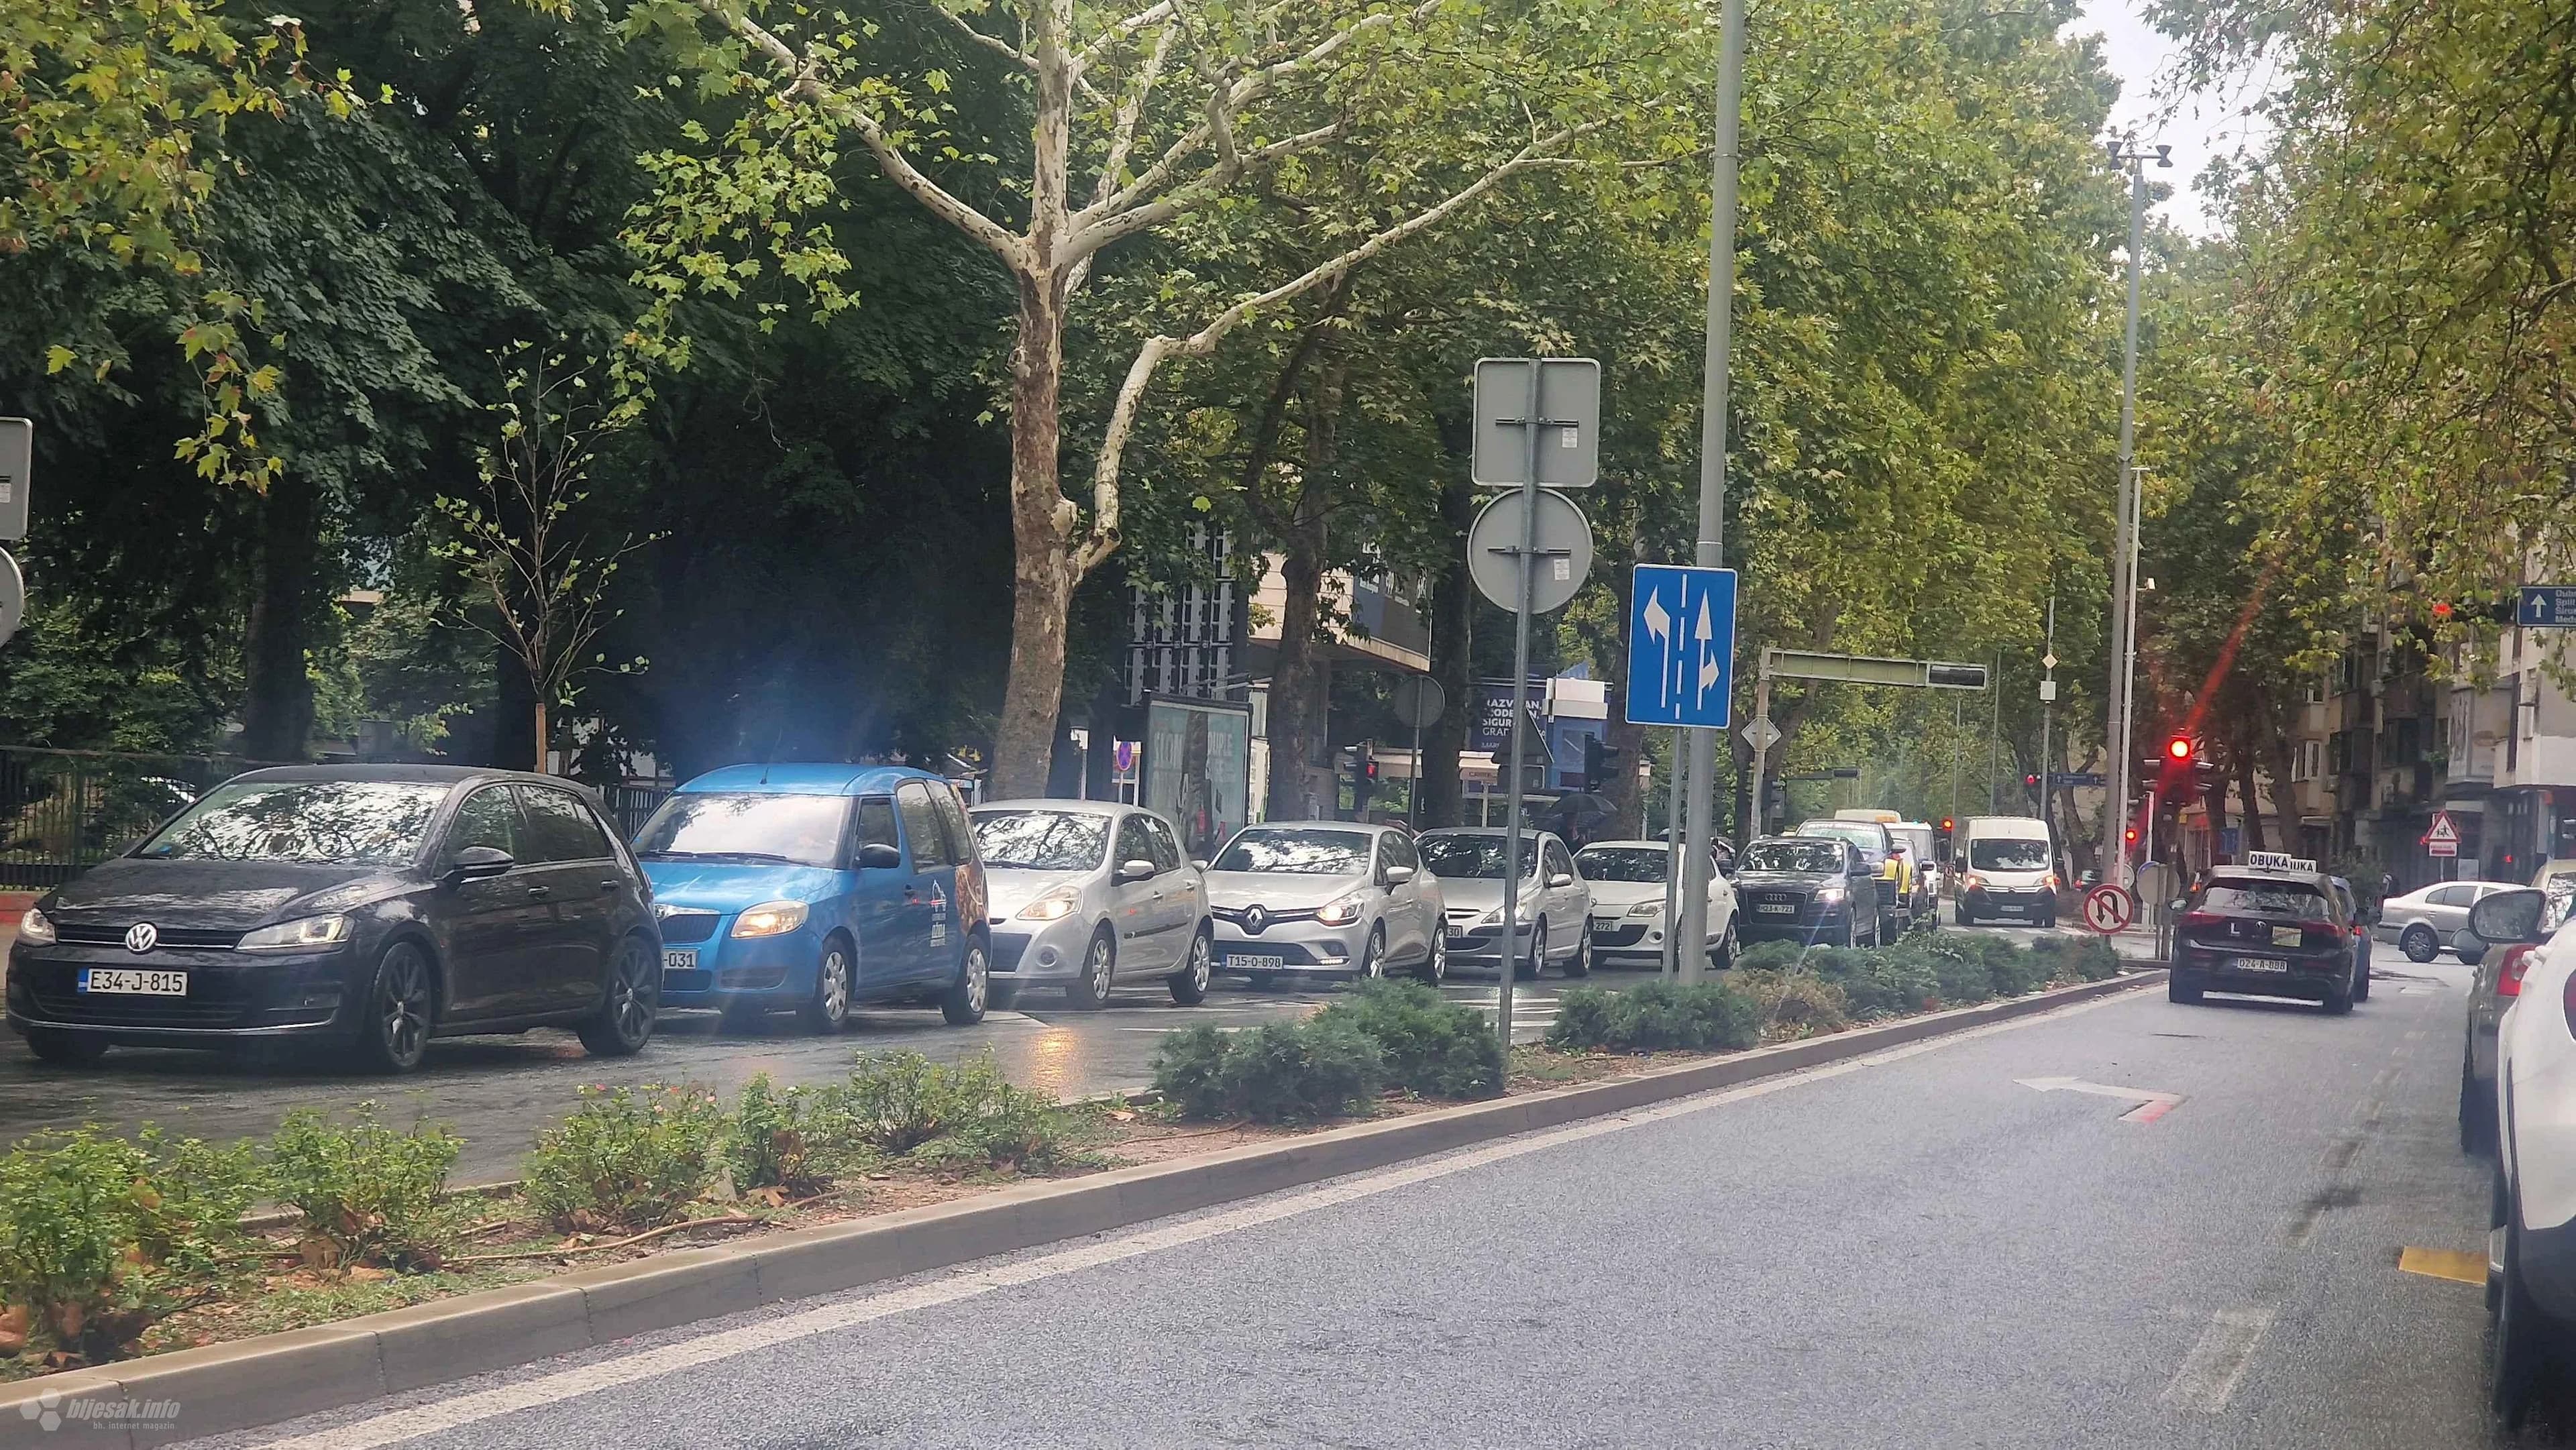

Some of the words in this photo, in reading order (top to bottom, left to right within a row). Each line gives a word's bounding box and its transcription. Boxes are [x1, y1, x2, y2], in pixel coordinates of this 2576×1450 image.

[2250, 854, 2288, 868] OBUKA
[2290, 861, 2313, 873] UKA
[91, 971, 183, 992] E34-J-815
